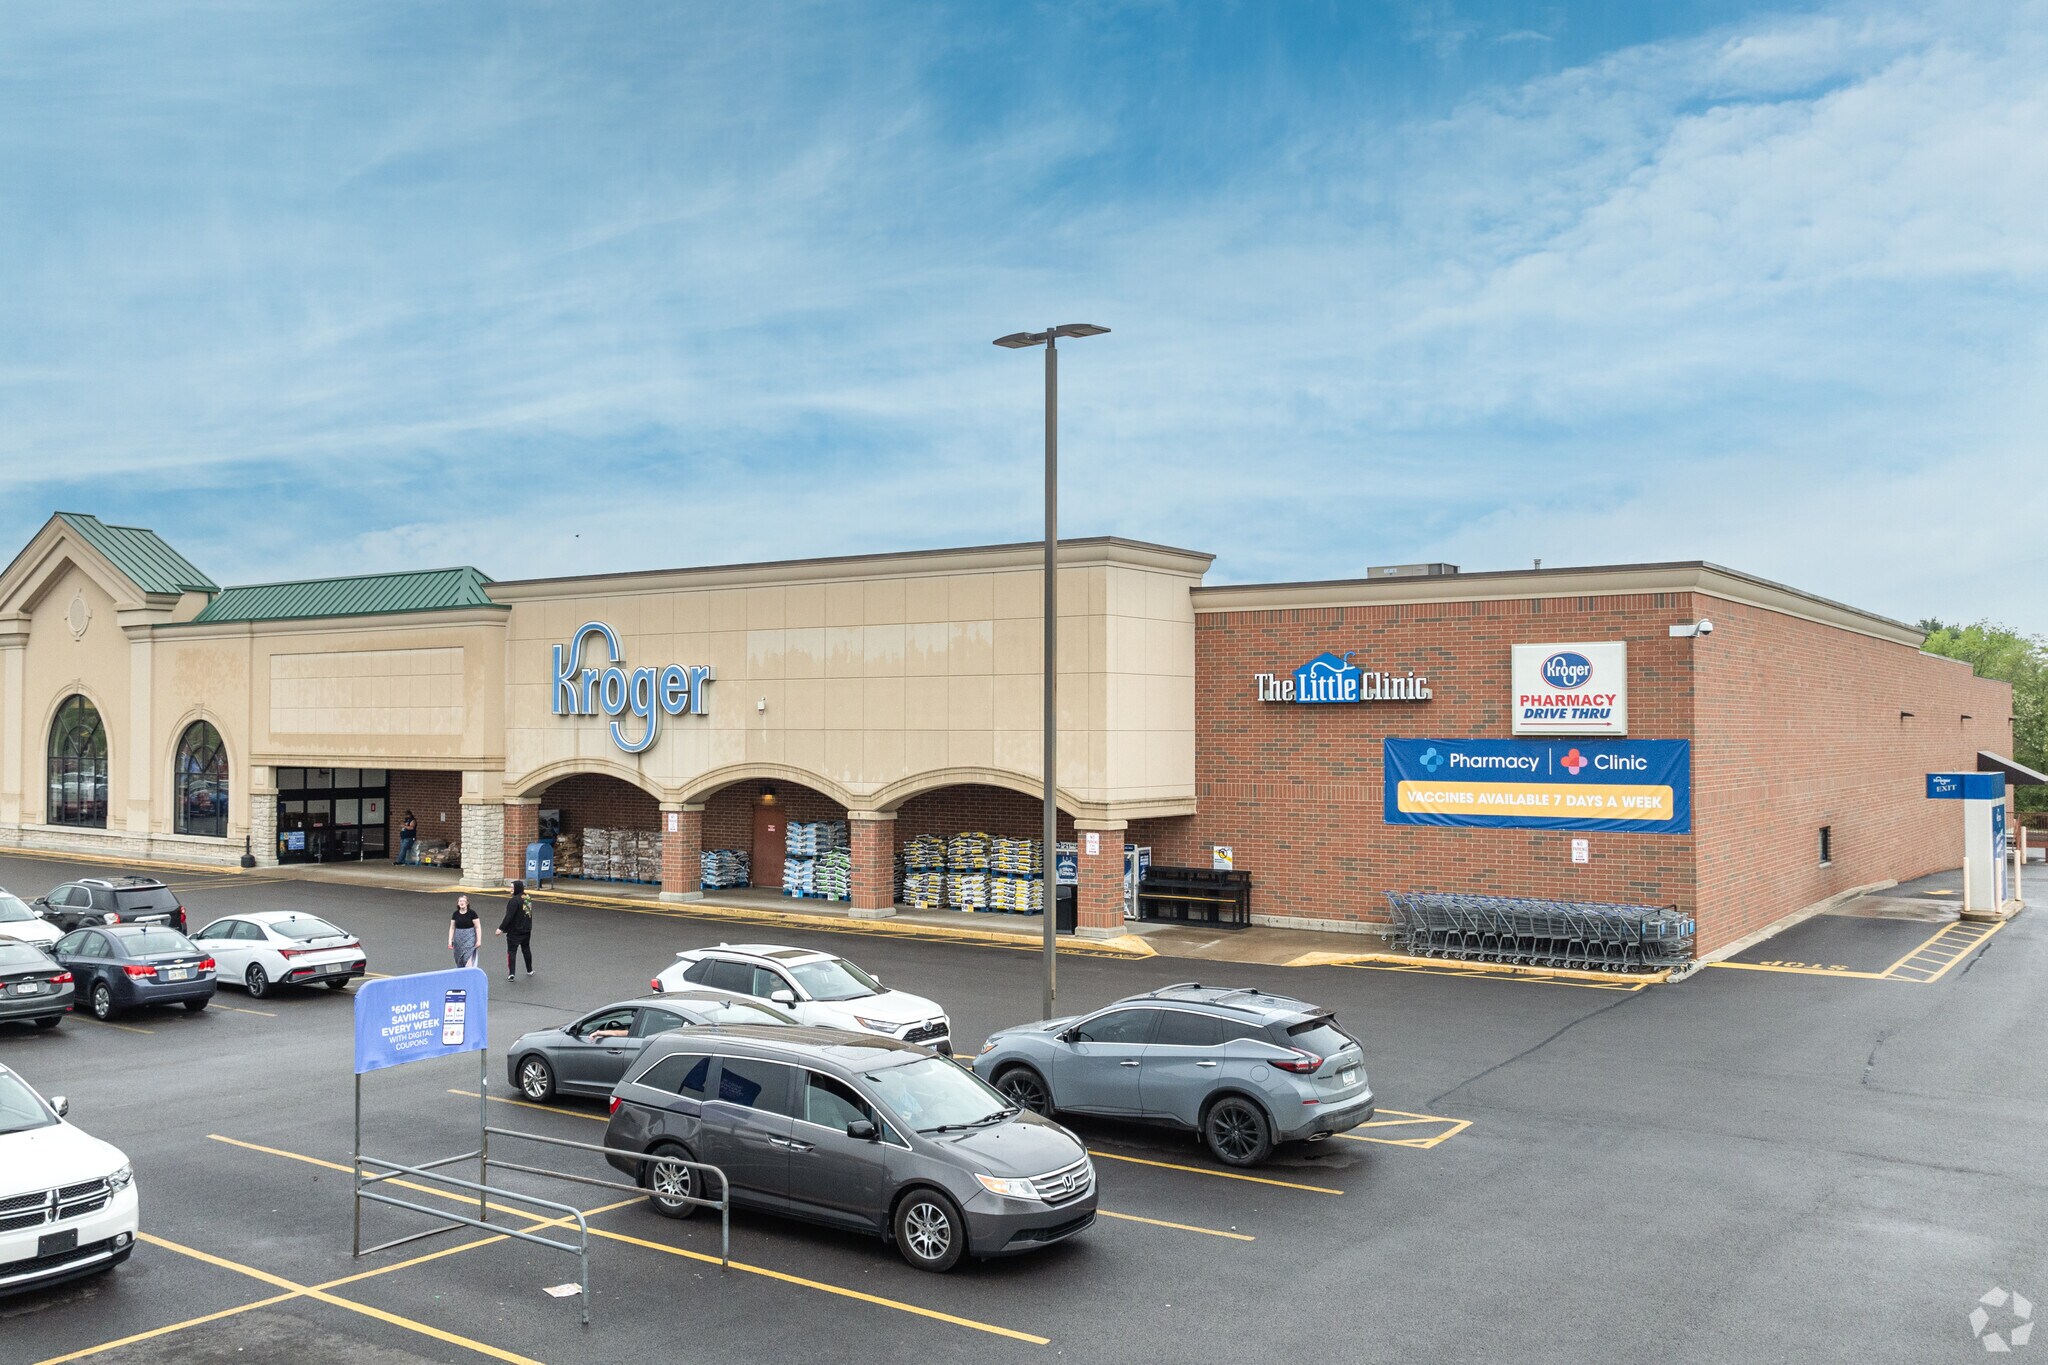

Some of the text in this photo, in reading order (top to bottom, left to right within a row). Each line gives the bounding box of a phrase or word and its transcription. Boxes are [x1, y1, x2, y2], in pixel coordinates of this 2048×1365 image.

[1546, 656, 1590, 686] Kroger
[552, 620, 714, 753] Kroger
[1254, 671, 1428, 701] The Little Clinic
[1520, 694, 1617, 707] PHARMACY
[1523, 708, 1612, 719] DRIVE THRU
[1450, 753, 1648, 772] Pharmacy Clinic
[1936, 784, 1957, 792] EXIT
[1407, 791, 1663, 809] VACCINES AVAILABLE 7 DAYS A WEEK
[391, 1000, 430, 1014] $600+ IN
[391, 1010, 430, 1025] SAVINGS
[381, 1018, 440, 1037] EVERY WEEK
[389, 1029, 434, 1043] WITH DIGITAL
[395, 1038, 429, 1051] COUPONS
